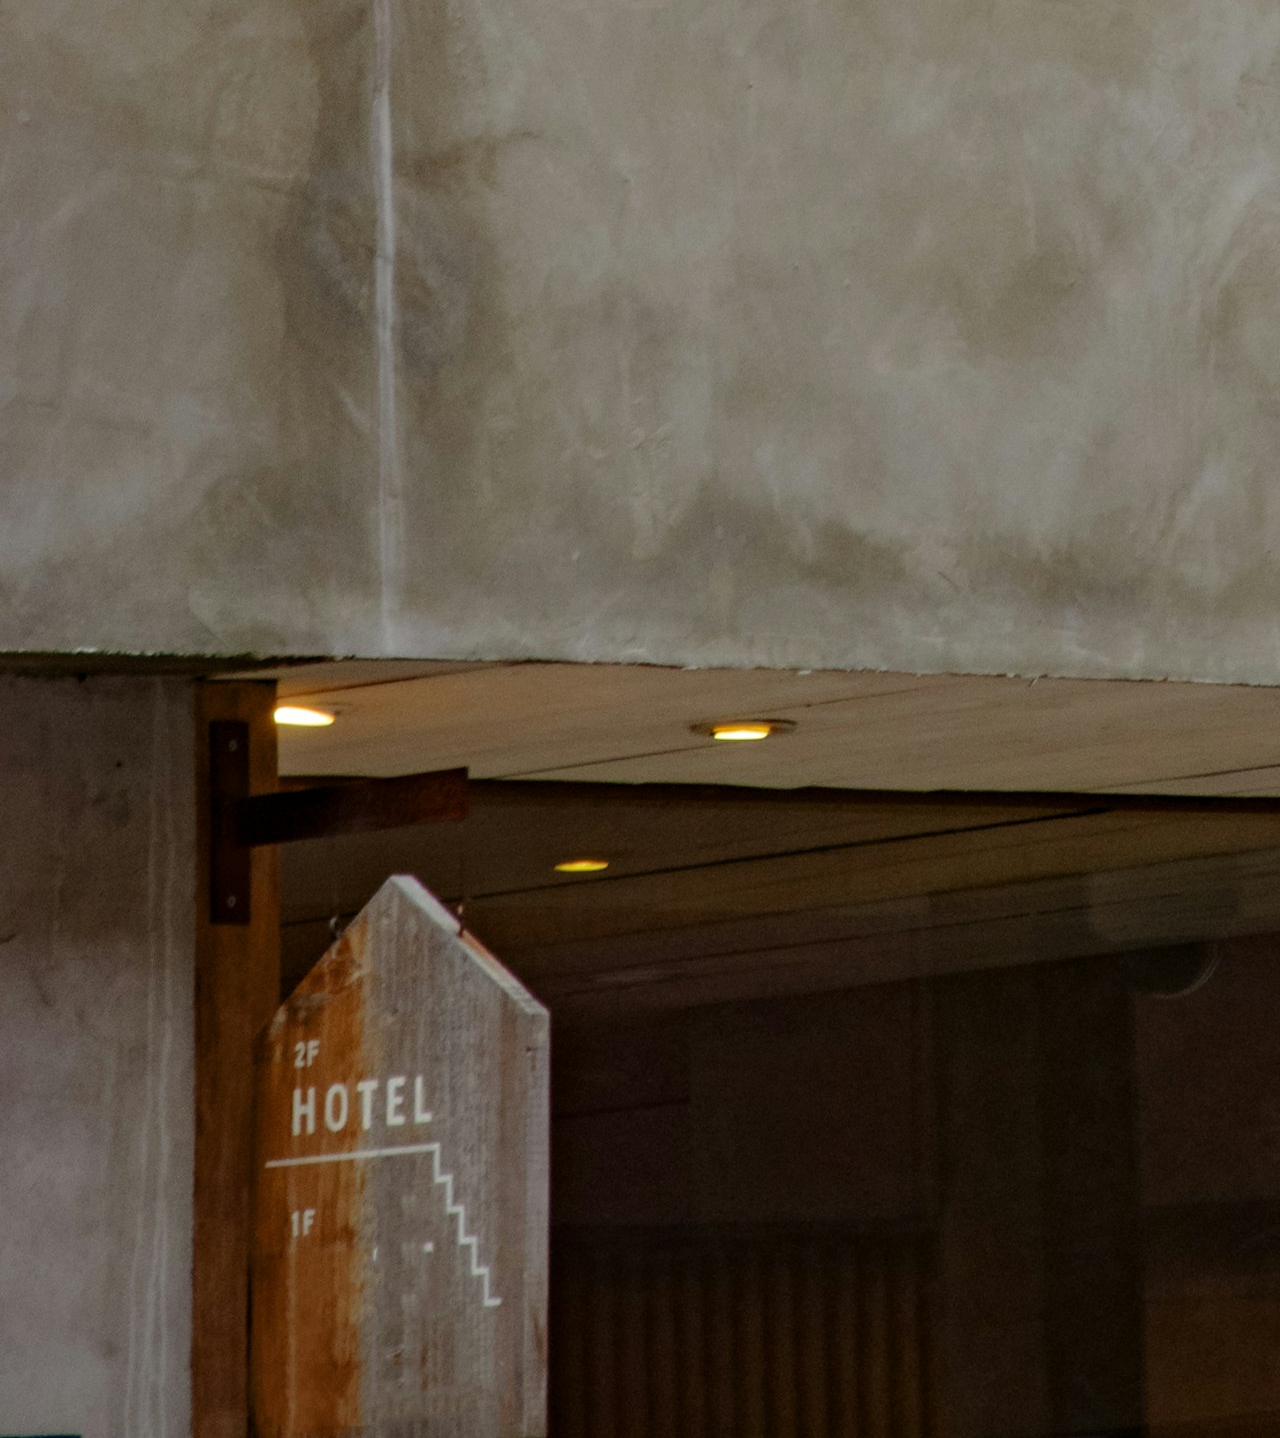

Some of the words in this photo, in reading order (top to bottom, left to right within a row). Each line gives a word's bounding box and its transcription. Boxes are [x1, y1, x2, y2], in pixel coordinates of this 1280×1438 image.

[294, 1040, 320, 1068] 2F
[292, 1075, 433, 1136] HOTEL
[291, 1209, 316, 1237] 1F
